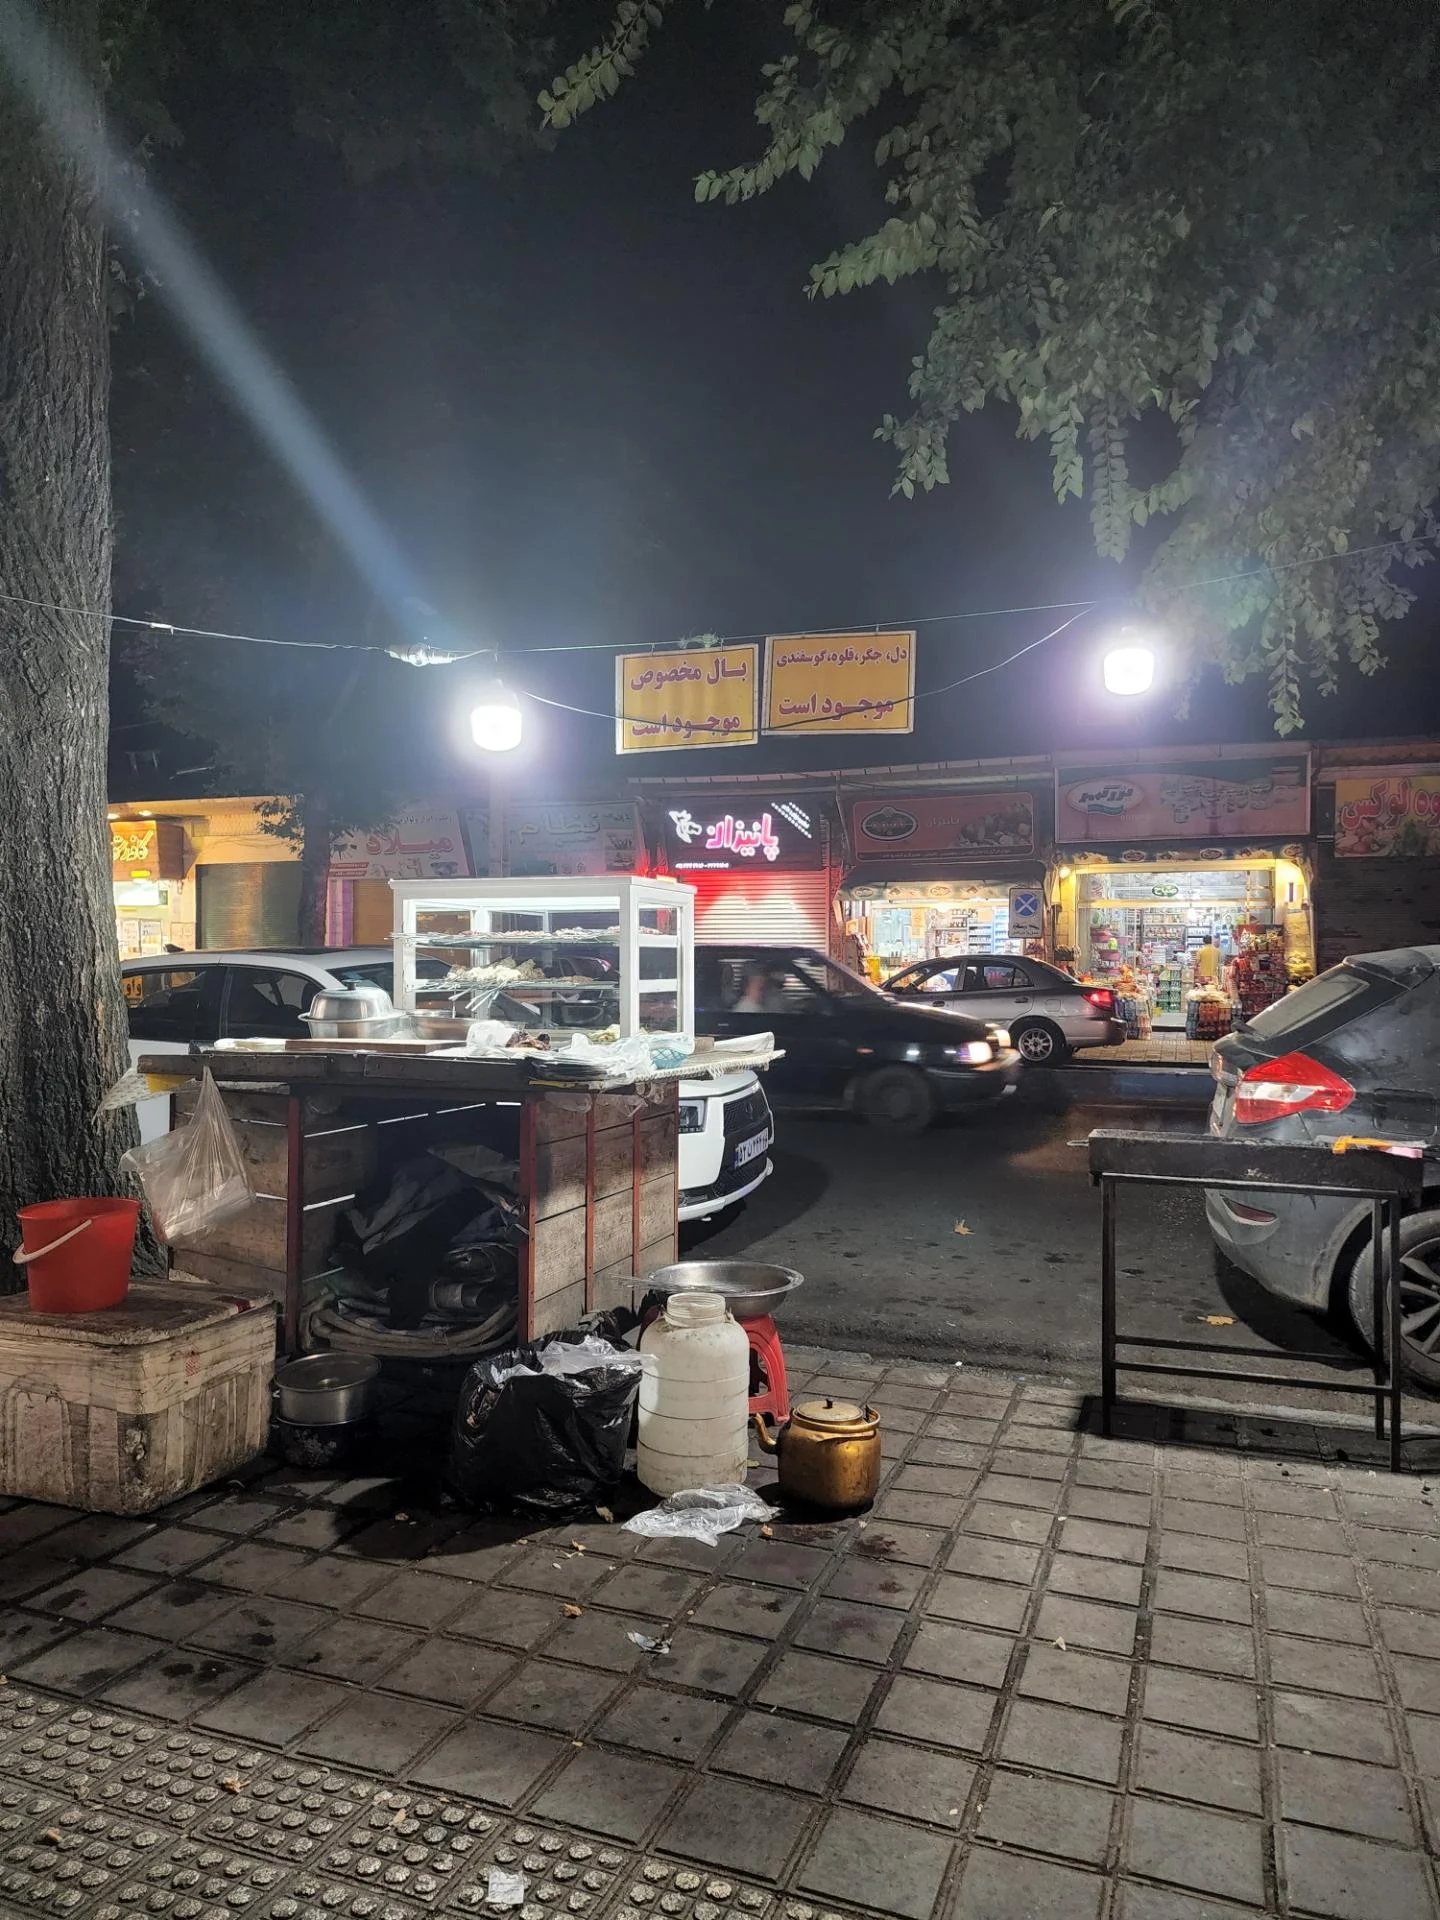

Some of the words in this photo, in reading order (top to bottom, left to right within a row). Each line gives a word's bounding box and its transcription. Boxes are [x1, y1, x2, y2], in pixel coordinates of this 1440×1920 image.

[630, 661, 702, 691] مخصوص
[707, 658, 747, 685] بال
[779, 693, 817, 715] است
[822, 697, 895, 721] موجود
[631, 713, 667, 736] است
[672, 716, 741, 739] موجود
